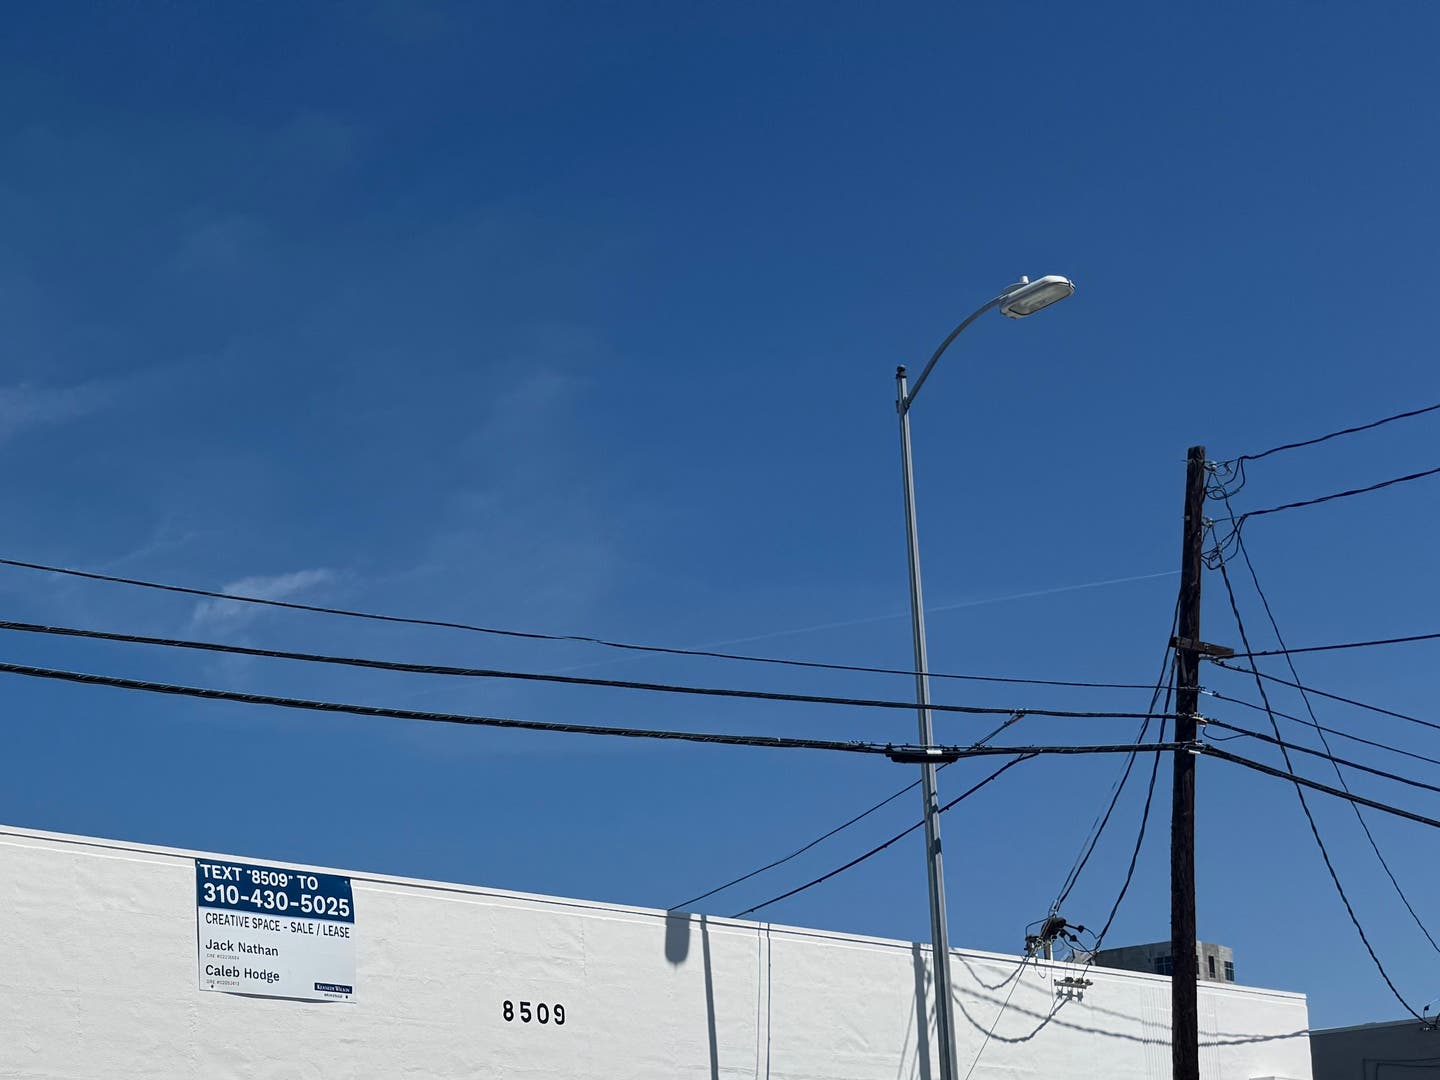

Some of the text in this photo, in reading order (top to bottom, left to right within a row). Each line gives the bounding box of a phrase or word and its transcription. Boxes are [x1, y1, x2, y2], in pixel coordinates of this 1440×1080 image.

[200, 863, 242, 881] TEXT
[297, 875, 319, 891] TO
[203, 882, 350, 917] 310-430-5025
[205, 912, 250, 929] CREATIVE
[252, 917, 281, 931] SPACE
[290, 921, 314, 935] SALE
[322, 924, 350, 939] LEASE
[205, 938, 279, 956] Jack Nathan
[205, 964, 240, 978] Caleb
[244, 967, 280, 984] Hodge
[503, 1000, 565, 1026] 8509
